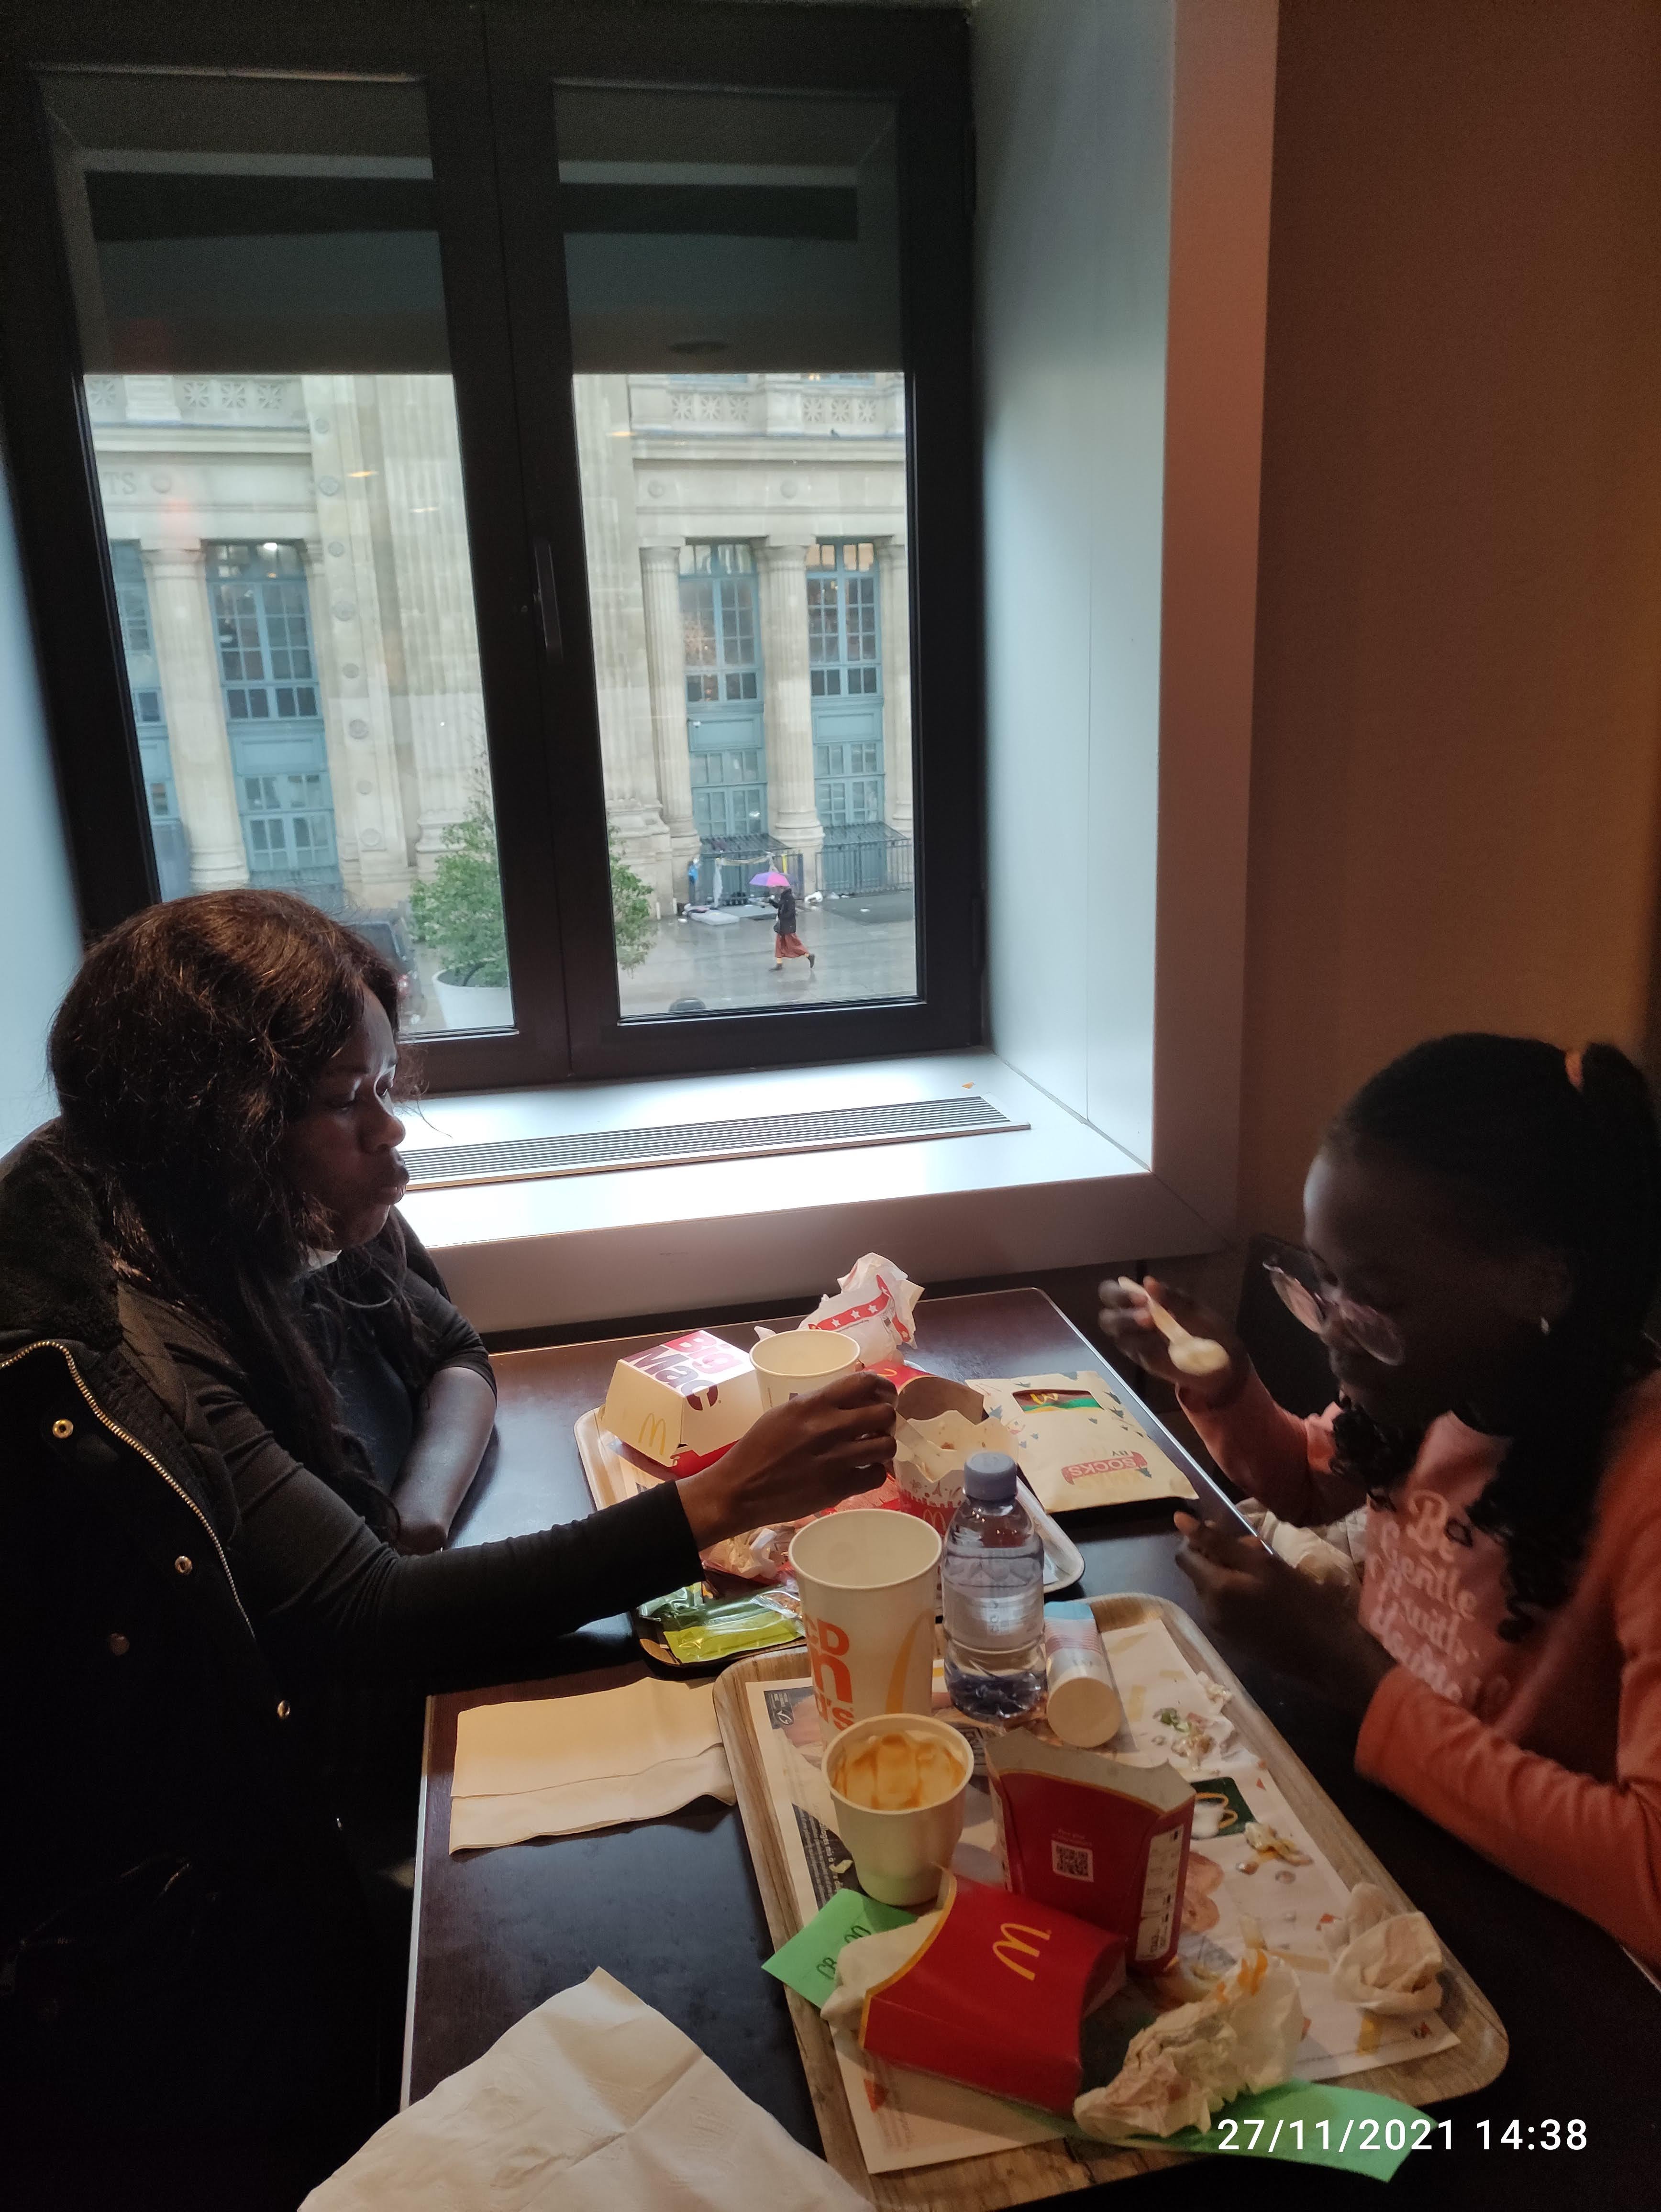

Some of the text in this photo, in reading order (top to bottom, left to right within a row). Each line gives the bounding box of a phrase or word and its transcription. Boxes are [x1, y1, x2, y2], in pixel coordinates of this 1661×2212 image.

[663, 1331, 743, 1374] Big
[623, 1346, 719, 1411] Mac
[1068, 1458, 1137, 1477] SOCKS
